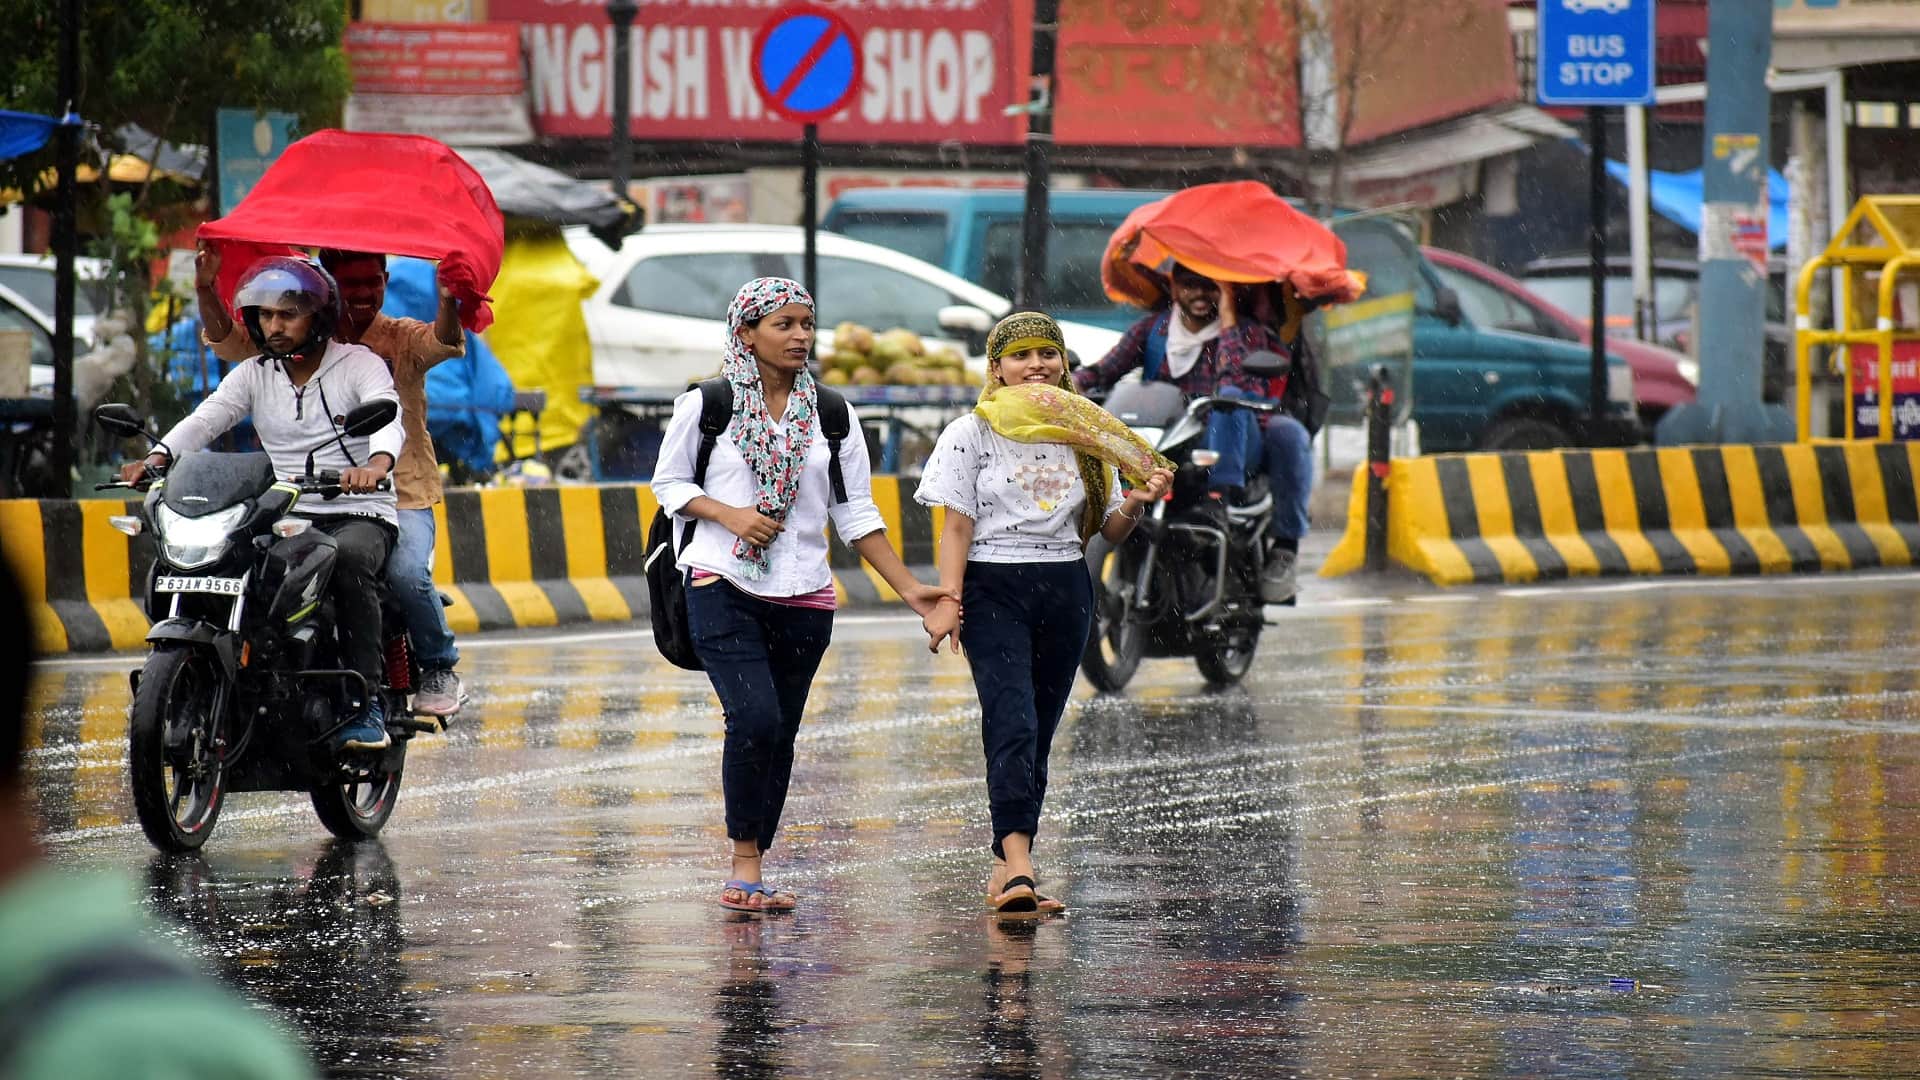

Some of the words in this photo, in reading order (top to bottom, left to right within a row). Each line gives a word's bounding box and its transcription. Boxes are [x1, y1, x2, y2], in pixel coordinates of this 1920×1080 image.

[1567, 34, 1625, 58] BUS
[522, 24, 708, 119] NGISH
[861, 27, 995, 125] SHOP
[1559, 62, 1634, 86] STOP
